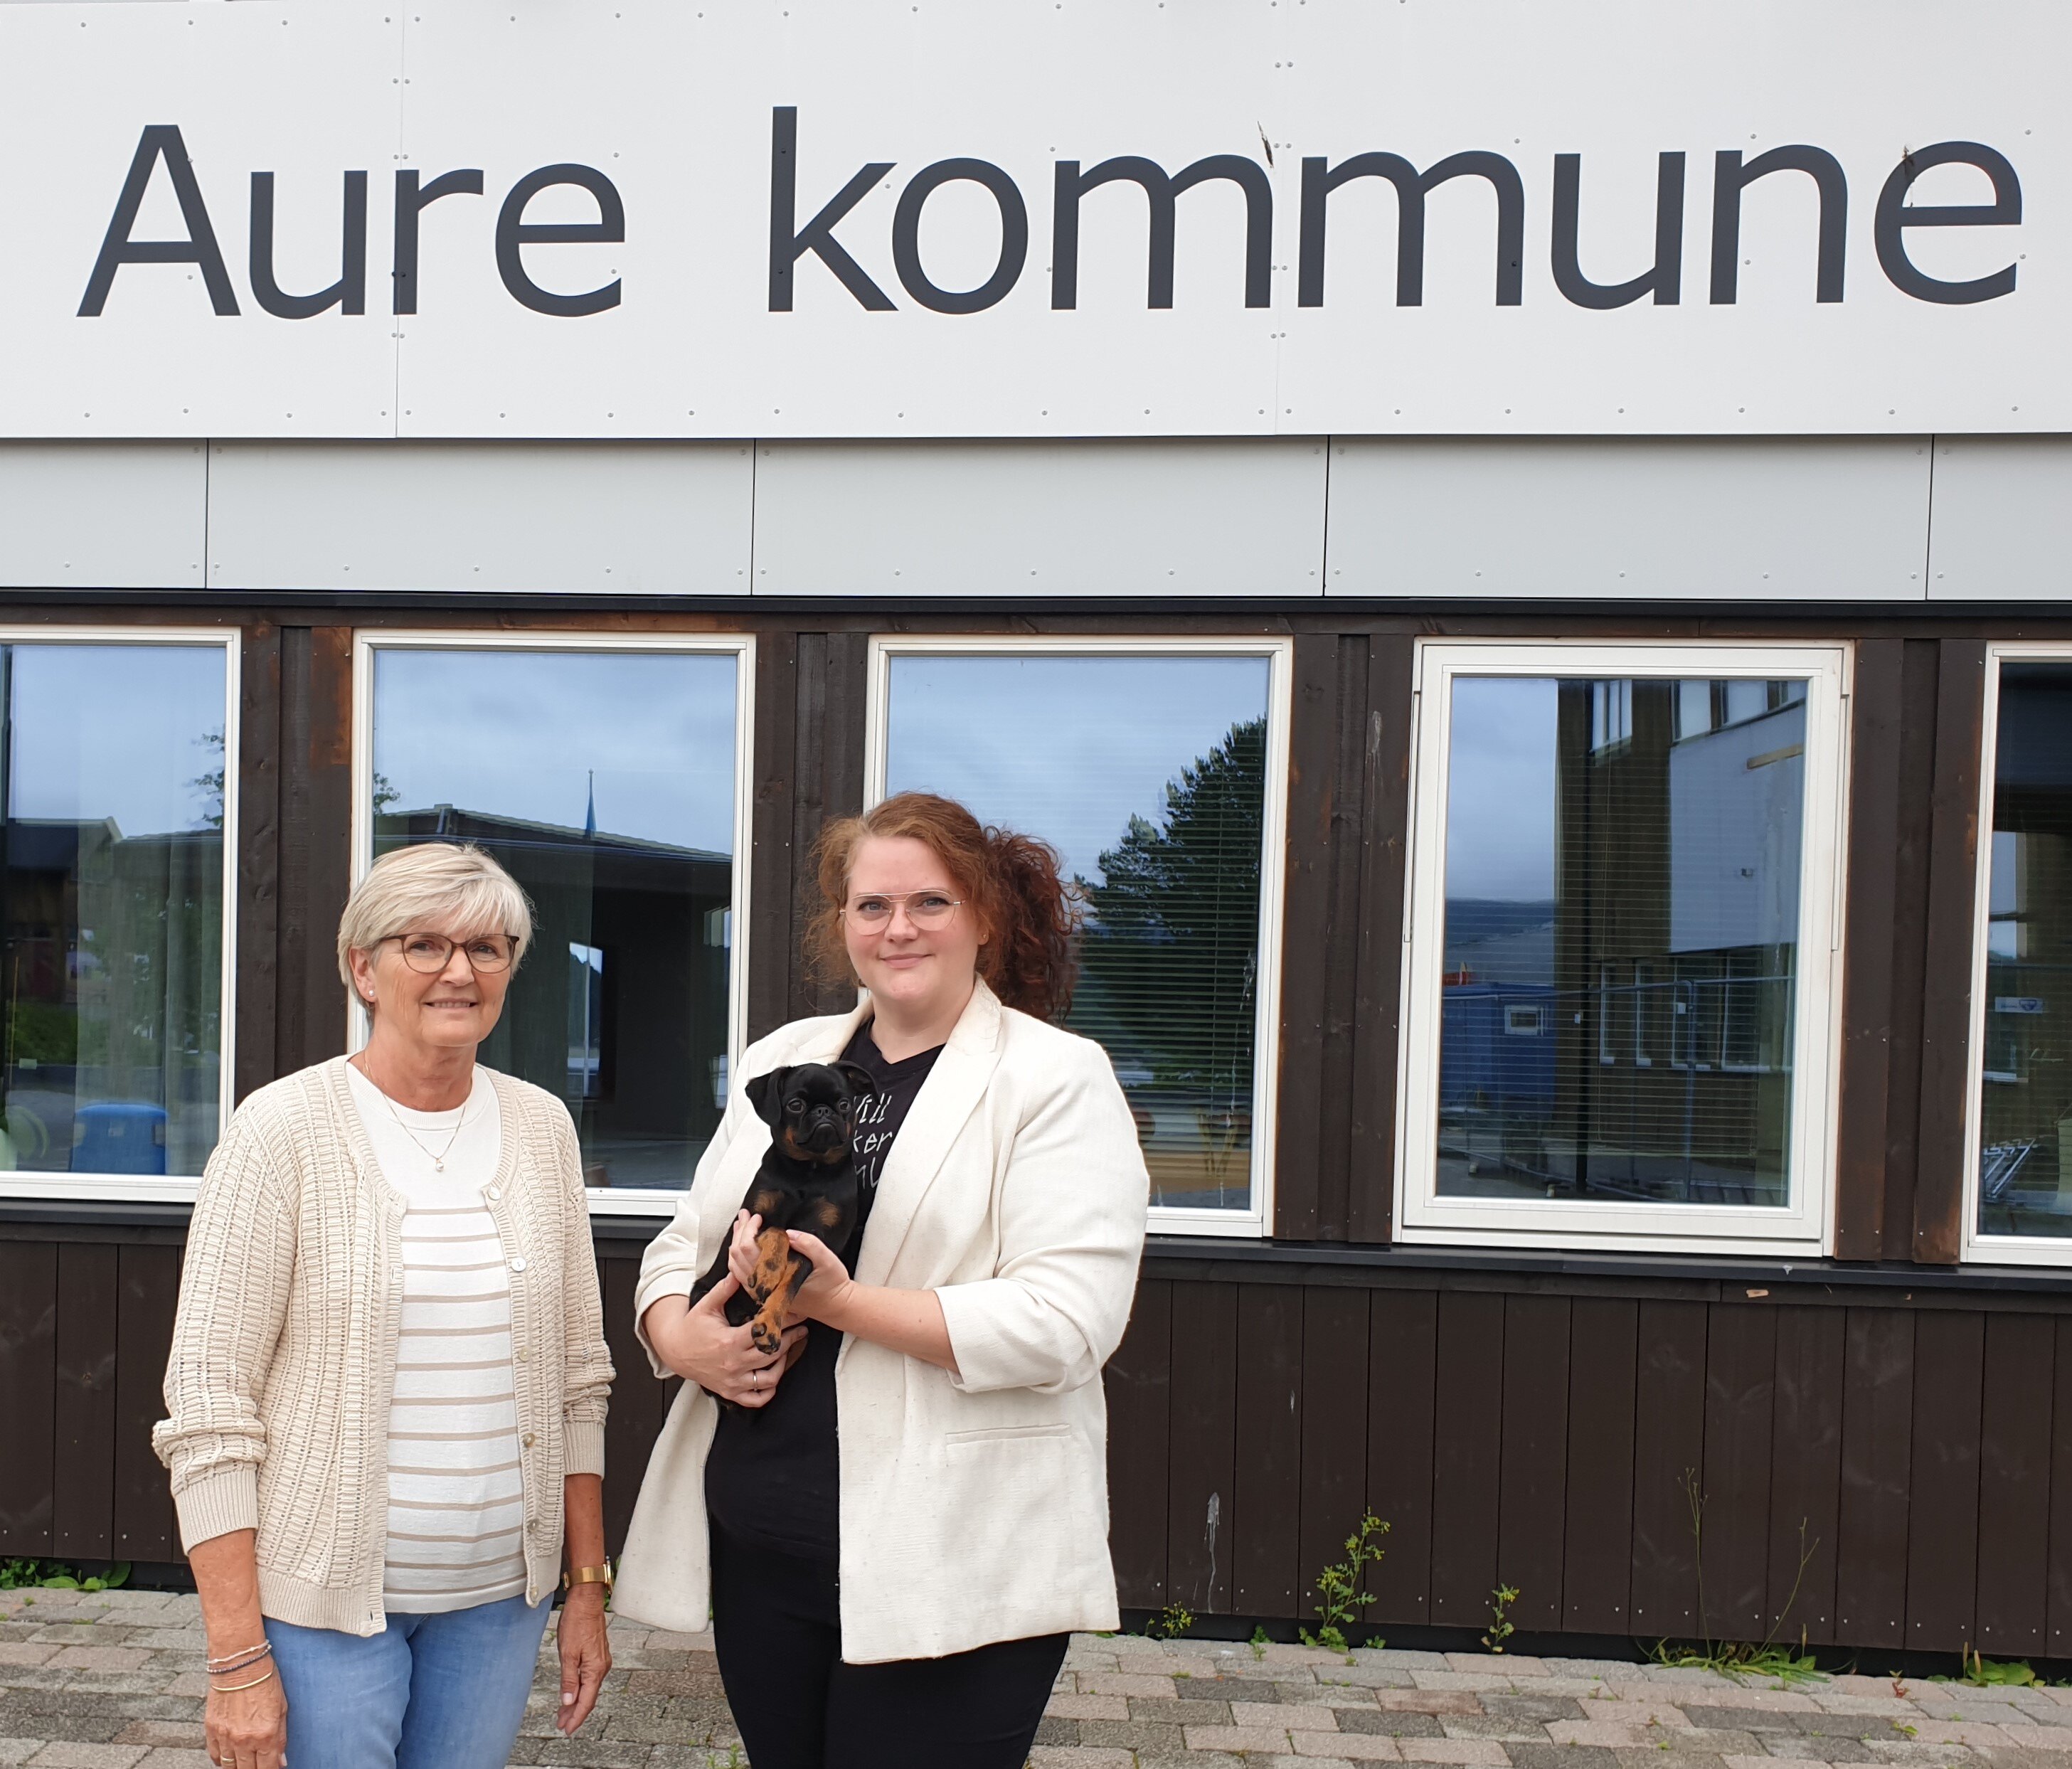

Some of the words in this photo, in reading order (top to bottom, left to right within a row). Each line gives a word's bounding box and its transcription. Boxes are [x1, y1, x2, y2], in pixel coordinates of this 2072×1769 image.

[77, 125, 625, 320] Aure
[768, 107, 2022, 315] kommune
[853, 1130, 893, 1154] ker
